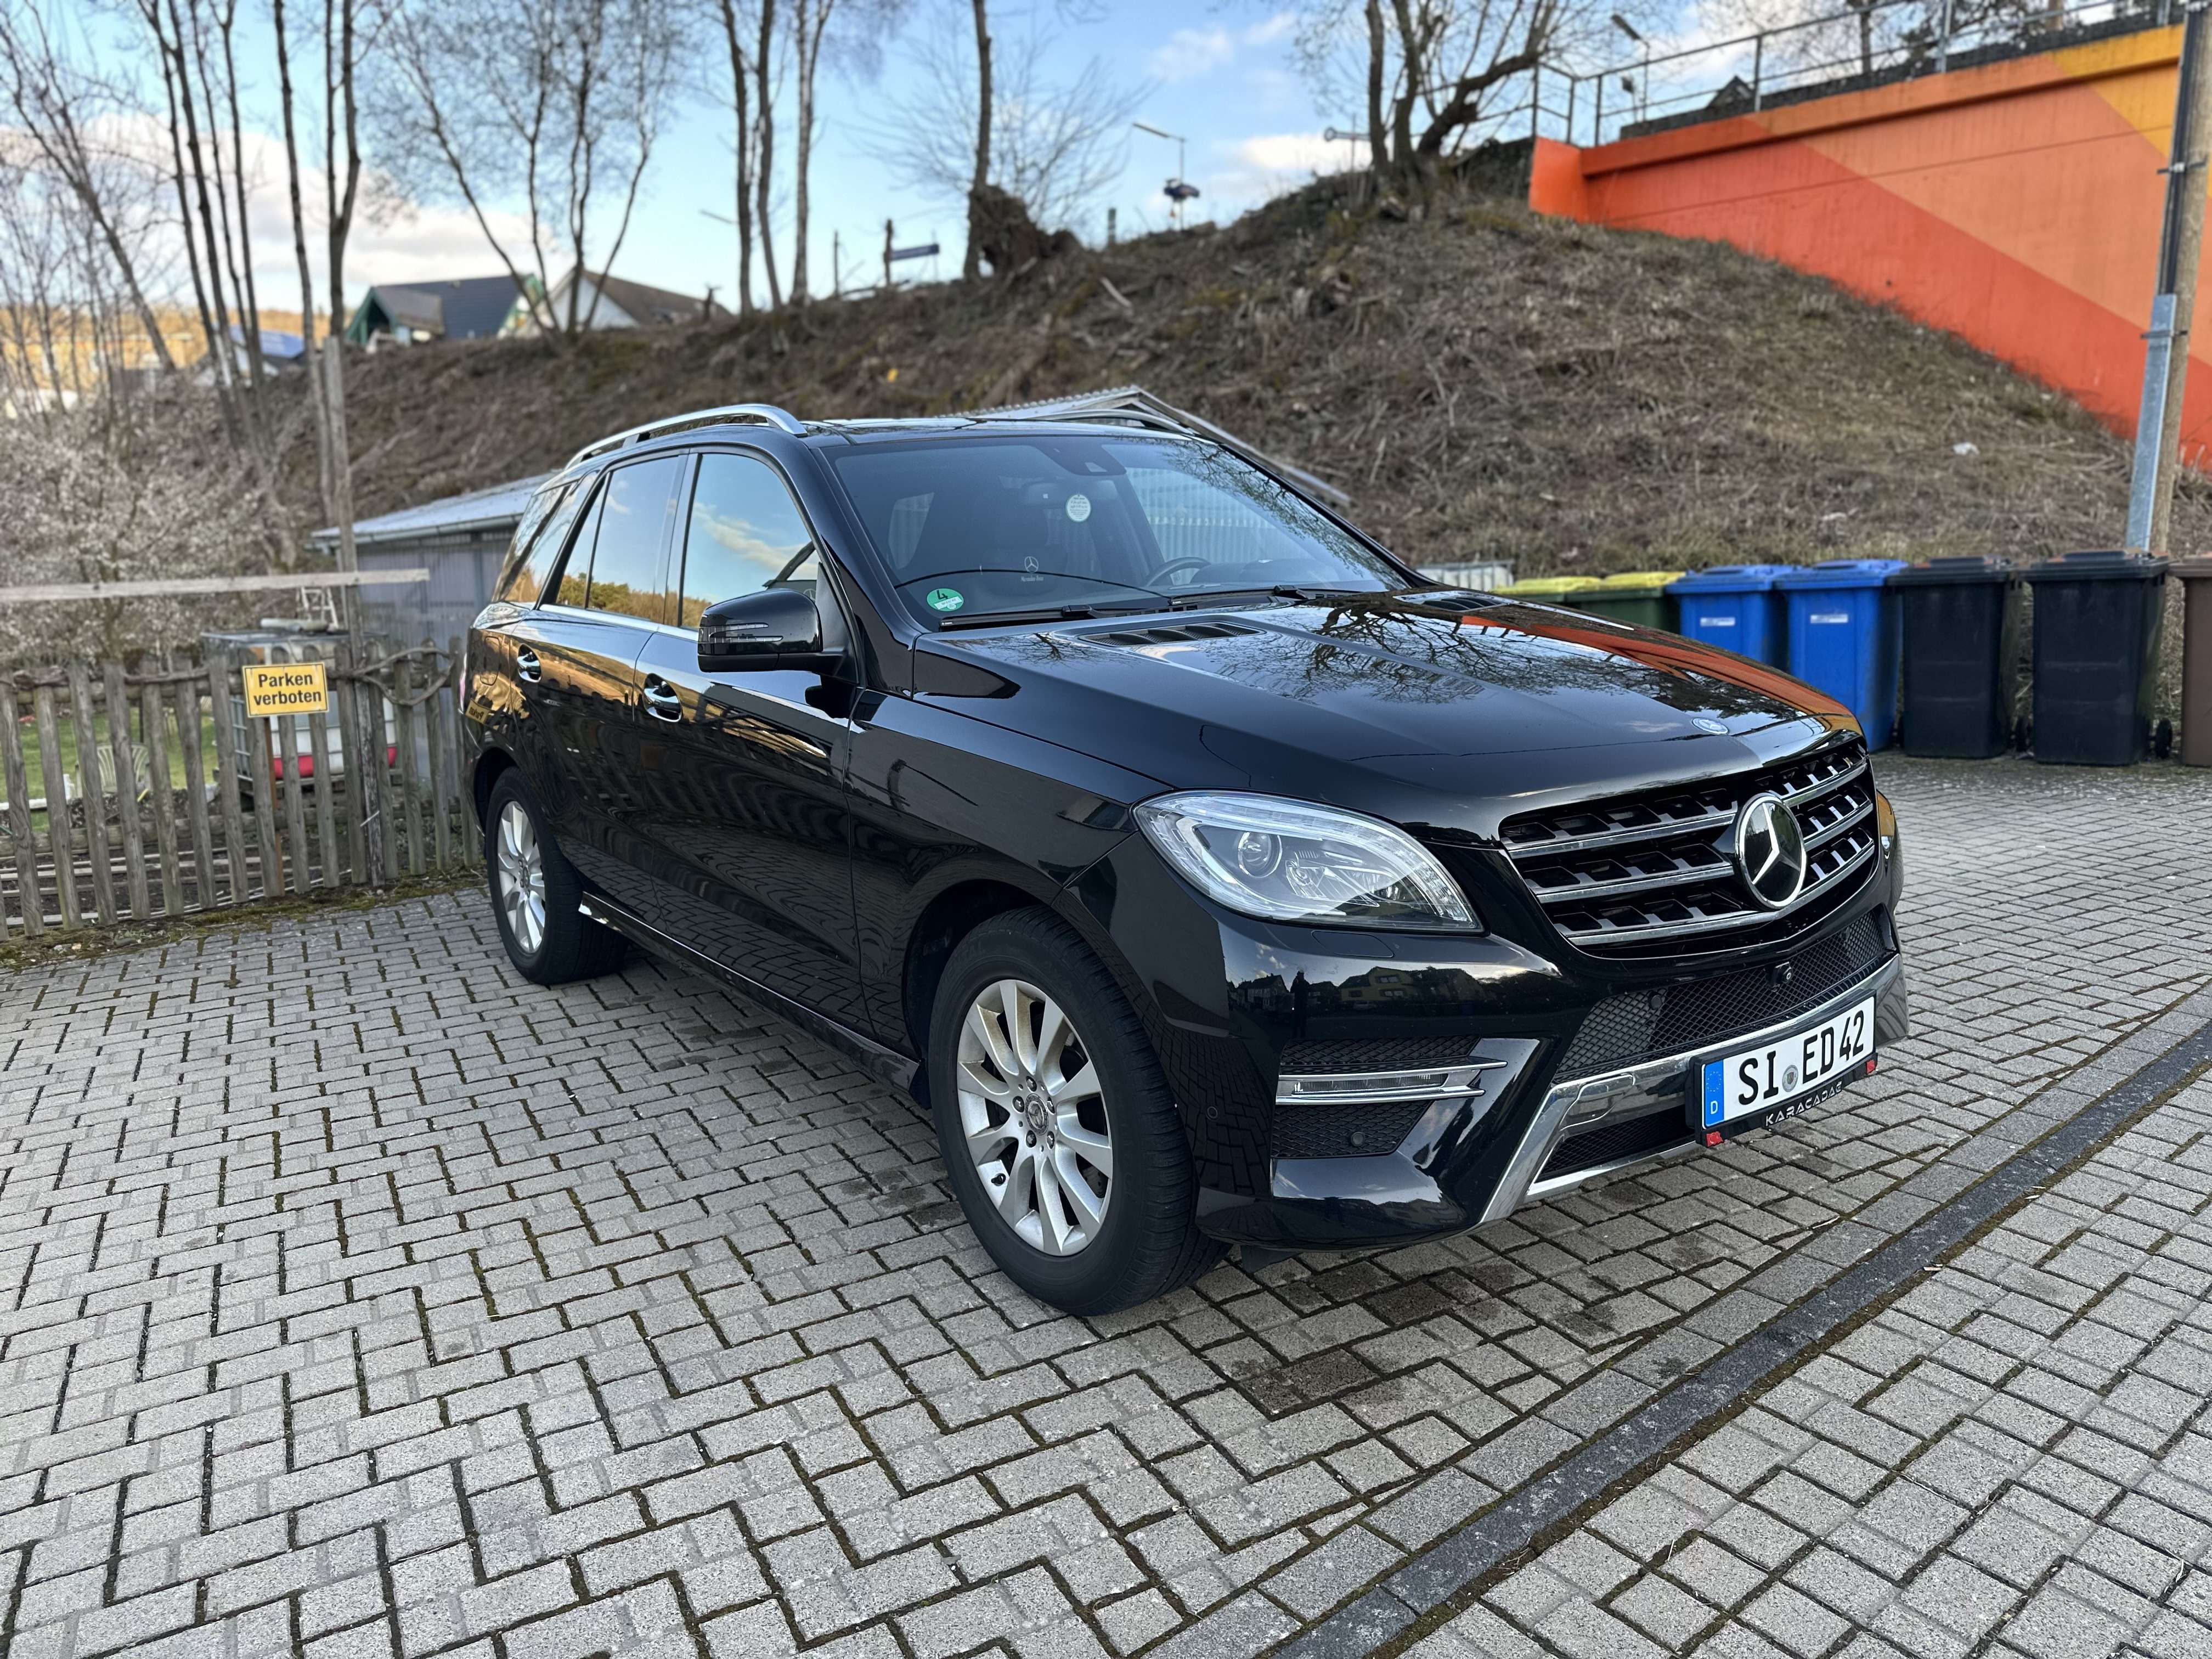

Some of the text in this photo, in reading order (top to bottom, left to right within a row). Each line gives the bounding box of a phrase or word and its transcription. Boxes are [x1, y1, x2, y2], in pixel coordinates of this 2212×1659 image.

[936, 590, 948, 600] 4
[258, 673, 313, 687] Parken
[253, 690, 321, 706] verboten
[1738, 1051, 1779, 1105] SI
[1710, 1100, 1718, 1115] D
